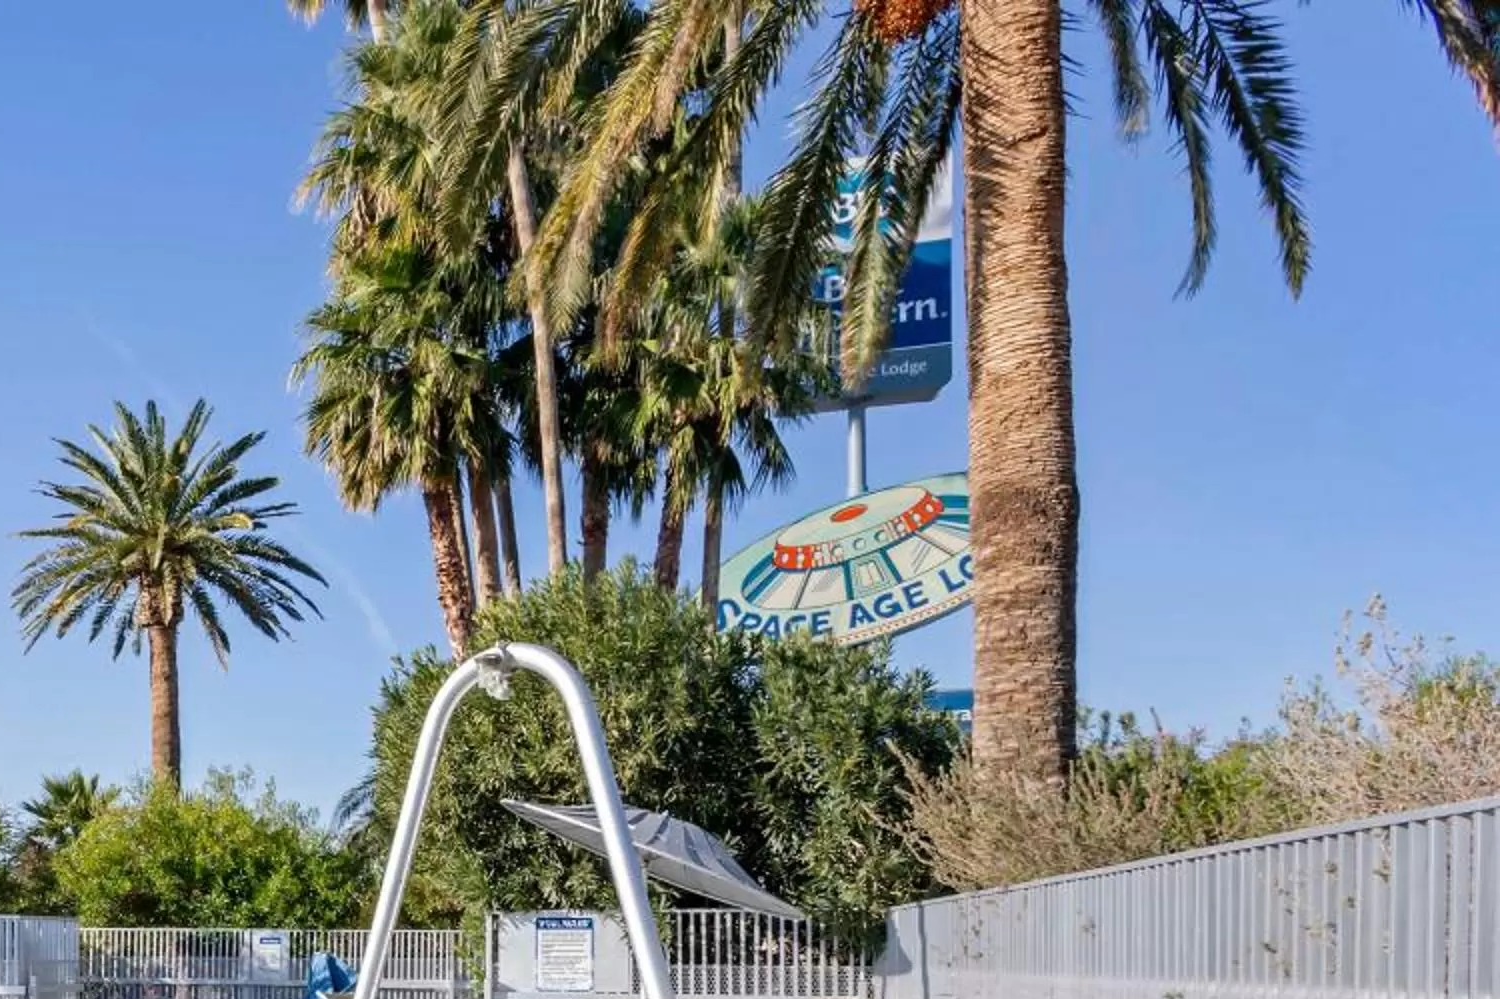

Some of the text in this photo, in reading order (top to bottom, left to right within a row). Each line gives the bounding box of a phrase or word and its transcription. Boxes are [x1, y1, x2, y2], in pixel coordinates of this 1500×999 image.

[880, 360, 928, 378] Lodge
[716, 596, 833, 642] SPACE
[850, 580, 929, 629] AGE
